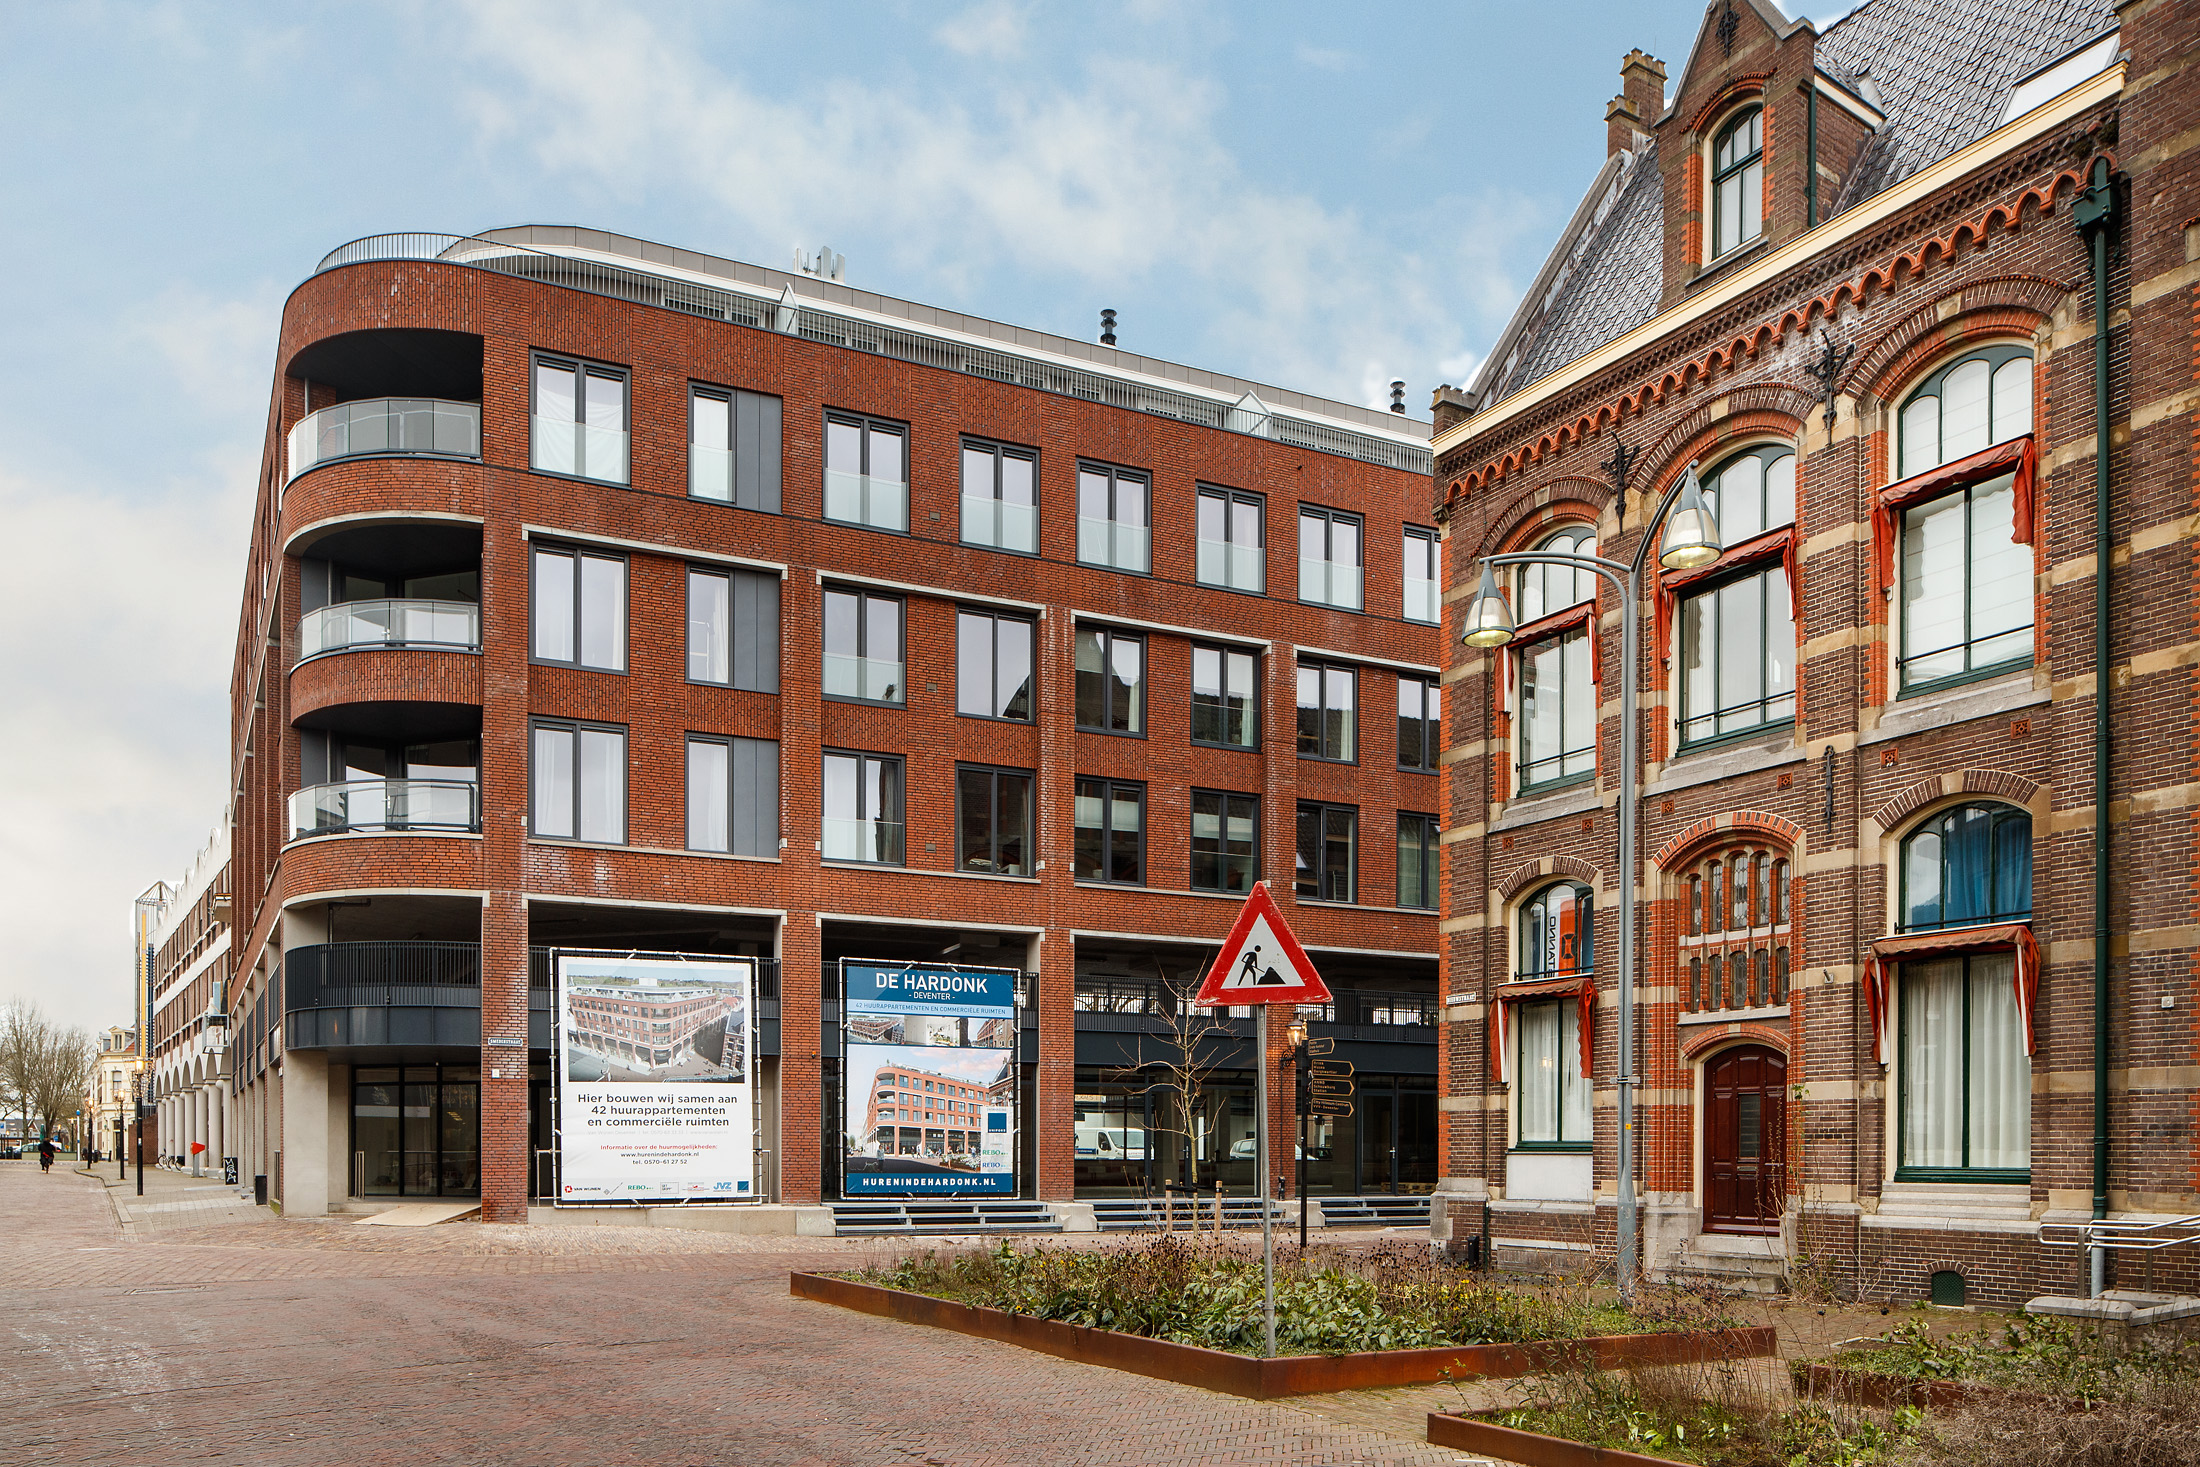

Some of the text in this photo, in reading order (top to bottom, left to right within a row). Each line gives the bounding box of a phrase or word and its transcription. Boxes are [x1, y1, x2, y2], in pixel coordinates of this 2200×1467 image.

[875, 972, 988, 993] DE HARDONK
[913, 991, 951, 1000] DEVENTER
[863, 1003, 930, 1011] HUURAPPARTEMENTEN
[578, 1093, 603, 1103] Hier
[606, 1093, 654, 1103] bouwen
[657, 1094, 674, 1104] wij
[677, 1095, 715, 1103] samen
[591, 1105, 726, 1116] 42 huurappartementen
[605, 1117, 682, 1126] commerciële
[685, 1117, 730, 1126] ruimten
[713, 1181, 732, 1190] JVZ
[862, 1178, 997, 1186] HURENINDEHARDONK.NL
